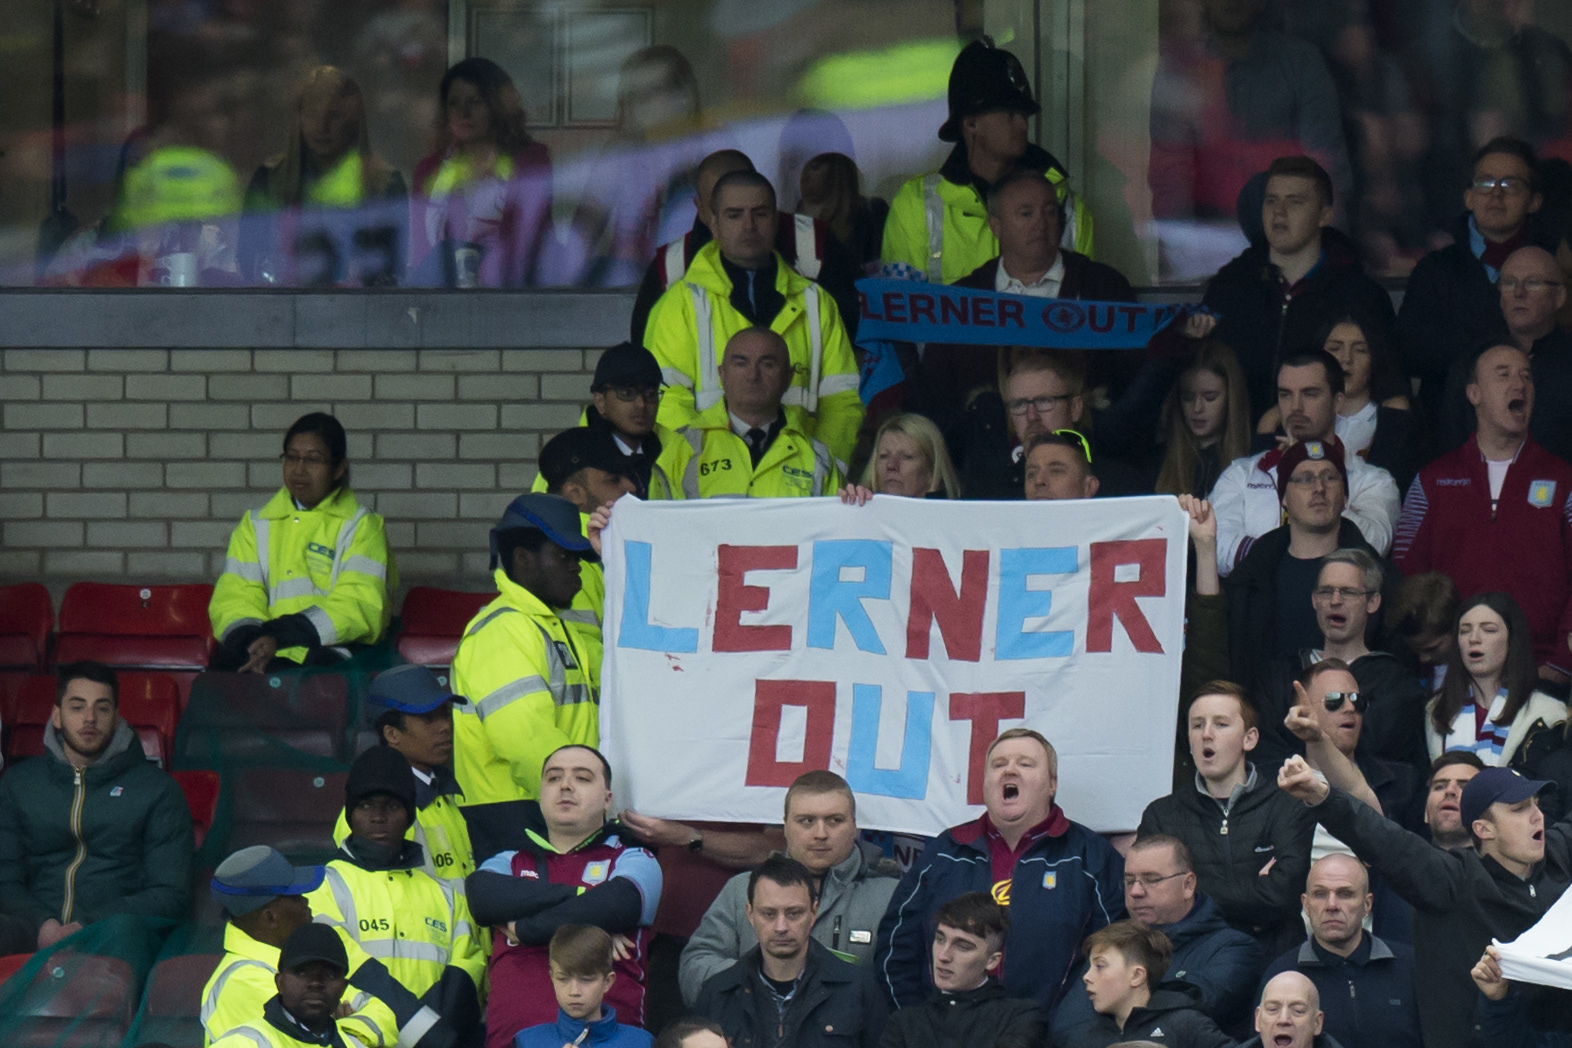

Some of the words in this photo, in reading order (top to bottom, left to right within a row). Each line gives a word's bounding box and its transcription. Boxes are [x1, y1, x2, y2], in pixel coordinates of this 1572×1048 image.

[861, 291, 1025, 330] LERNER
[700, 458, 732, 476] 673
[616, 538, 1167, 662] LERNER
[744, 679, 1026, 806] OUT
[359, 918, 389, 932] 045
